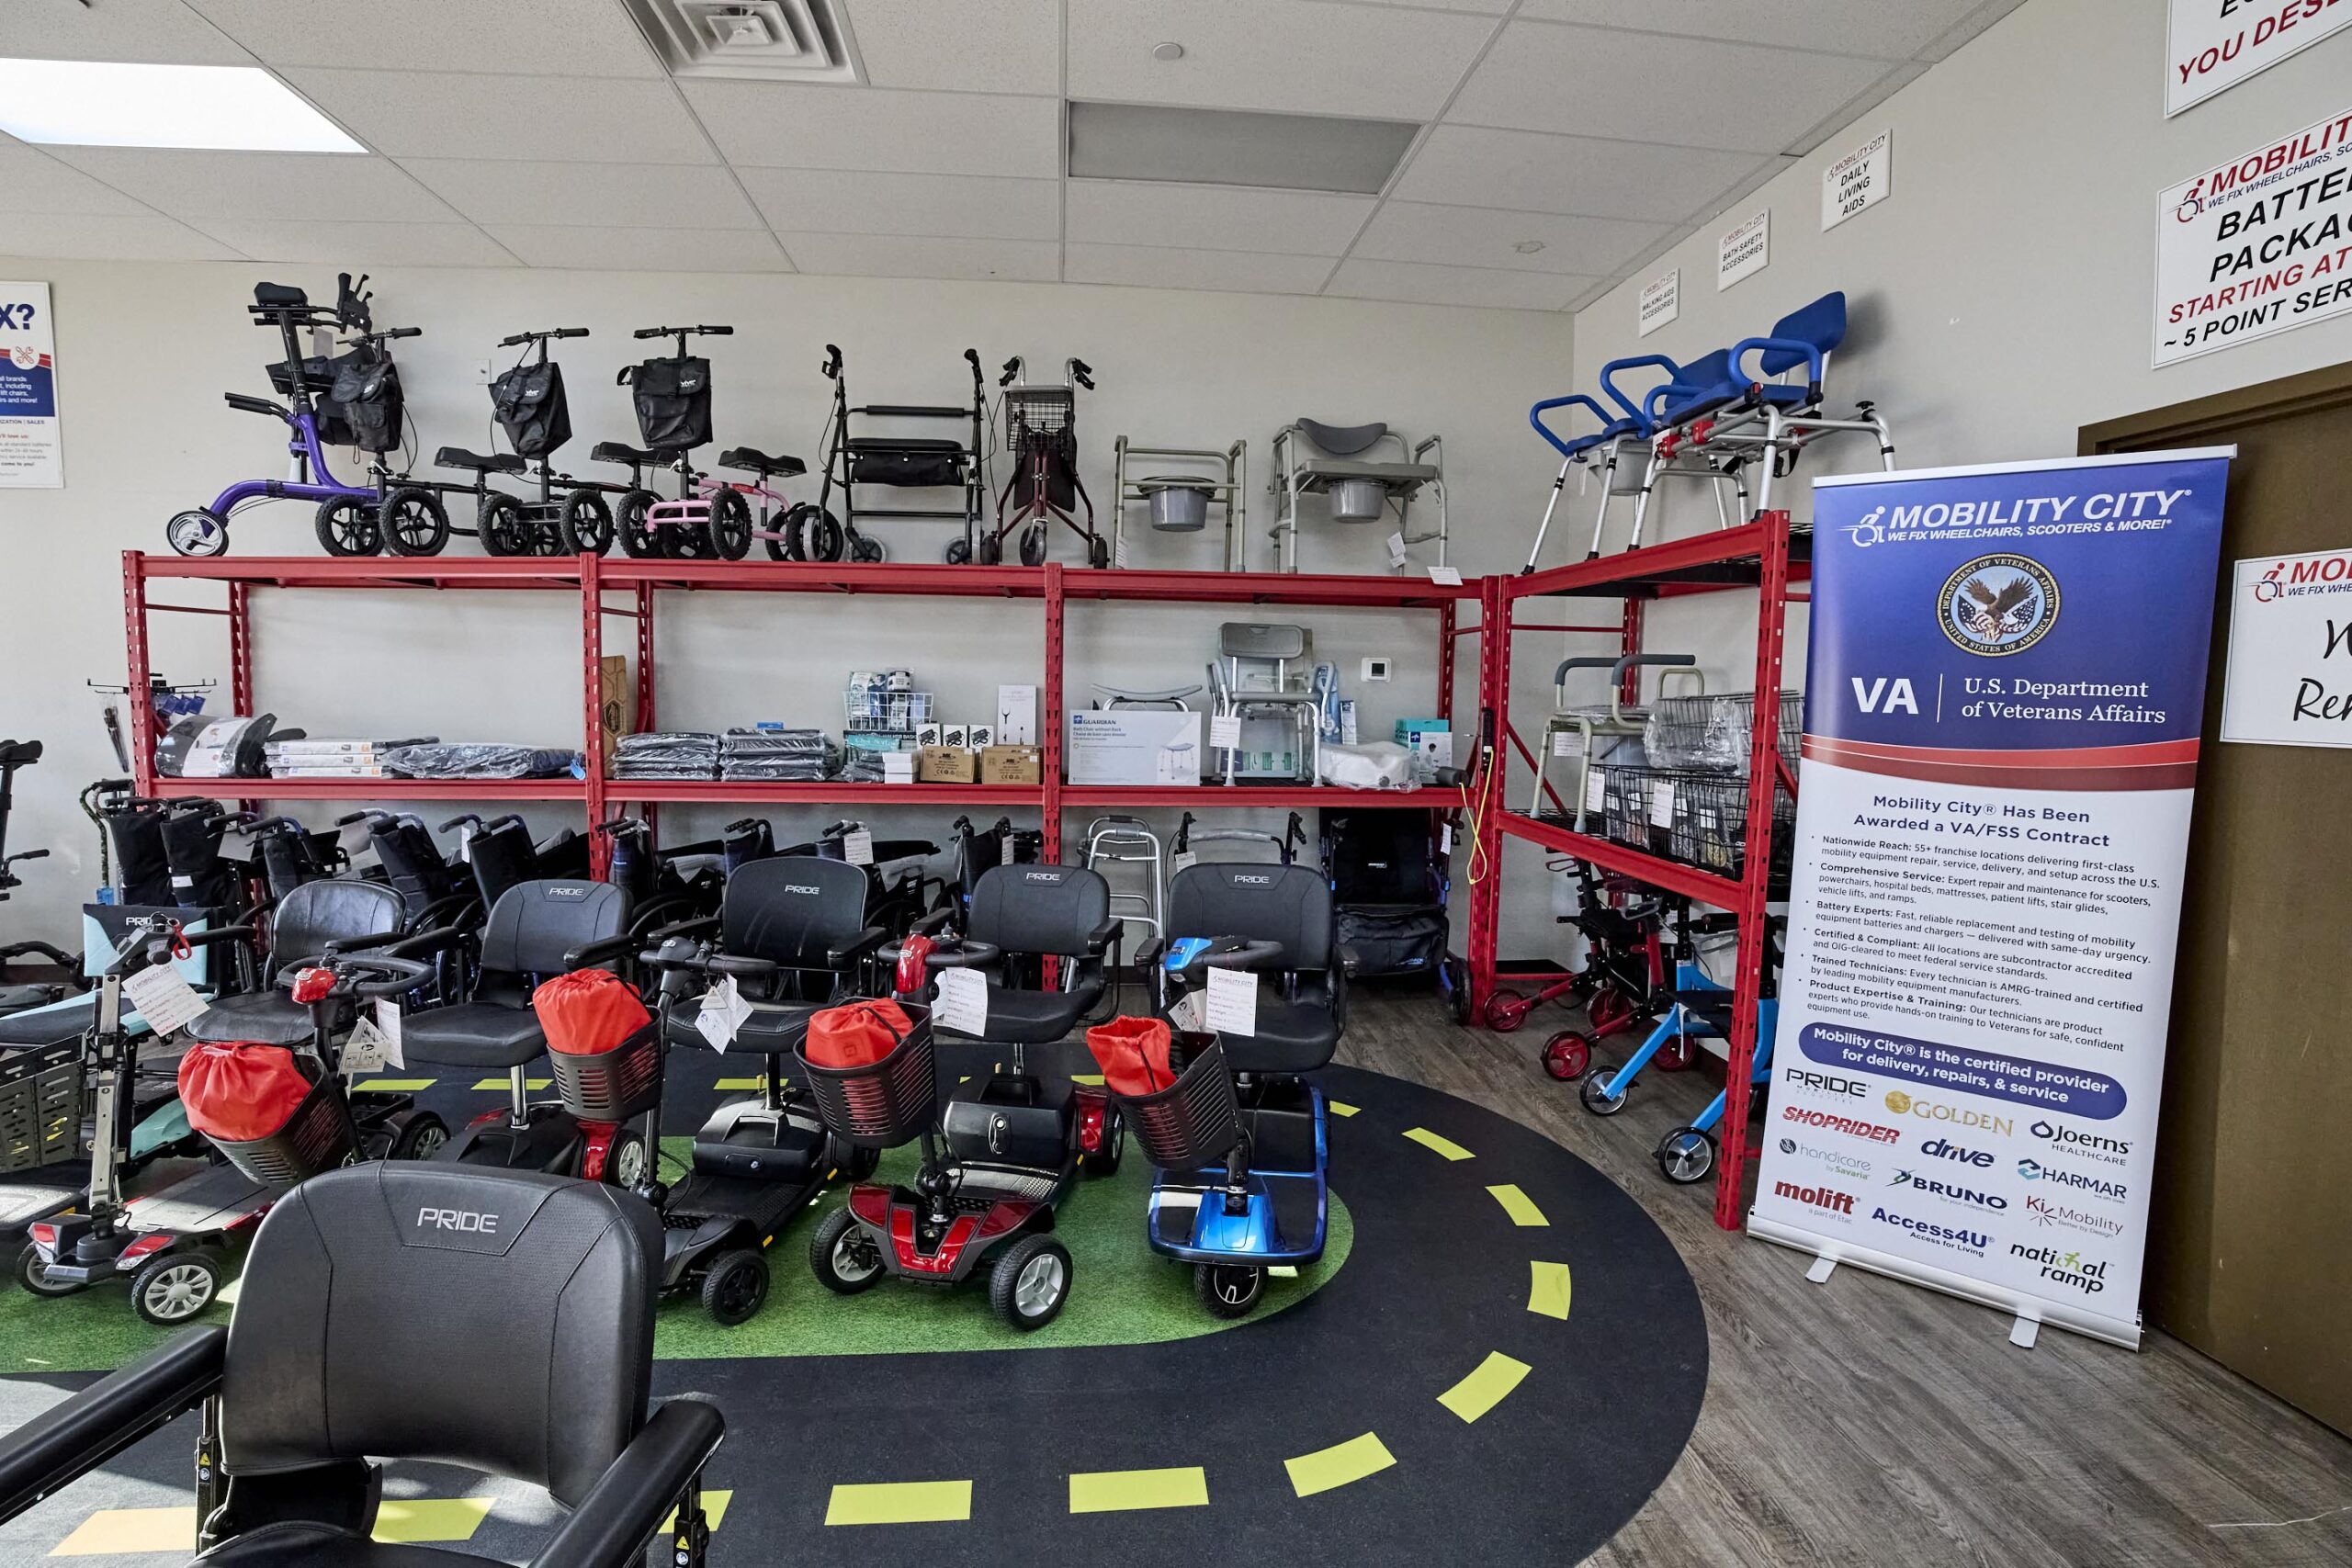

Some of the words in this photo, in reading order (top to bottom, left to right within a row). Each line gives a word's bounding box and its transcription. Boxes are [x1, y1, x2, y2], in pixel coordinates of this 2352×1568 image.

[2179, 31, 2244, 84] YOU
[1836, 144, 1869, 173] MOBILITY
[1870, 133, 1886, 151] CITY
[1841, 160, 1869, 186] DAILY
[2209, 196, 2225, 209] WE
[2227, 188, 2244, 201] FIX
[2246, 152, 2332, 193] WHEELCHAIRS,
[1838, 176, 1870, 203] LIVING
[2217, 167, 2352, 241] BATTE
[1842, 195, 1865, 216] AIDS
[1722, 242, 1763, 273] ACCESSORIES
[1723, 246, 1738, 262] BATH
[1739, 230, 1763, 252] SAFETY
[2210, 213, 2352, 282] PACKA
[2169, 264, 2303, 323] STARTING
[2311, 246, 2352, 278] AT
[1642, 294, 1663, 311] WALKING
[1642, 297, 1674, 321] ACCESSORIES
[2184, 327, 2196, 346] 5
[2203, 299, 2286, 342] POINT
[2293, 278, 2352, 313] SER
[1889, 494, 2076, 529] MOBILITY
[1887, 531, 1907, 541] WE
[1907, 530, 1929, 540] FIX
[1929, 525, 2023, 539] WHEELCHAIRS,
[2026, 522, 2102, 536] SCOOTERS
[2104, 521, 2115, 532] &
[1943, 565, 1976, 610] DEPARTMENT
[1979, 560, 1991, 569] OF
[1995, 558, 2041, 576] VETERANS
[2038, 575, 2053, 609] AFFAIRS
[2288, 587, 2305, 595] WE
[2308, 586, 2325, 594] FIX
[1945, 619, 1967, 644] UNITED
[1969, 641, 2000, 652] STATES
[2005, 642, 2016, 650] OF
[2019, 618, 2050, 647] AMERICA
[1851, 677, 1918, 715] VA
[1964, 677, 2006, 694] U.S.
[2013, 678, 2149, 700] Department
[1962, 700, 1984, 717] of
[1987, 702, 2082, 720] Veterans
[2086, 704, 2165, 724] Affairs
[1873, 795, 1941, 813] Mobility
[2003, 805, 2036, 818] Has
[2042, 807, 2089, 823] Been
[1853, 814, 1928, 830] Awarded
[1934, 823, 1944, 832] a
[1951, 821, 2019, 839] VA/FSS
[2026, 828, 2109, 847] Contract
[1822, 835, 1876, 848] Nationwide
[1879, 840, 1912, 852] Reach:
[1915, 843, 1931, 852] 55+
[1934, 845, 1977, 857] franchise
[1980, 850, 2025, 862] locations
[2027, 854, 2079, 869] delivering
[2082, 859, 2134, 874] first-class
[549, 887, 583, 897] PRIDE
[785, 885, 820, 895] PRIDE
[1026, 872, 1060, 882] PRIDE
[1234, 874, 1269, 884] PRIDE
[126, 917, 153, 926] PRID
[1816, 900, 1851, 913] Battery
[1853, 905, 1893, 918] Experts:
[1895, 909, 1917, 920] Fast,
[1918, 913, 1953, 925] reliable
[1955, 919, 2016, 932] replacement
[2018, 926, 2037, 935] and
[2040, 928, 2075, 942] testing
[2077, 933, 2088, 942] of
[2090, 936, 2136, 950] mobility
[1812, 953, 1847, 966] Trained
[1849, 959, 1906, 976] Technicians:
[1909, 968, 1936, 981] Every
[1938, 973, 1987, 987] technician
[1989, 980, 1997, 989] is
[1999, 982, 2072, 1001] AMRG-trained
[2074, 995, 2095, 1005] and
[2097, 999, 2143, 1012] certified
[1814, 1027, 1871, 1049] Mobility
[1919, 1046, 1931, 1059] is
[1935, 1050, 1961, 1065] the
[1964, 1056, 2031, 1078] certified
[2035, 1069, 2109, 1093] provider
[1842, 1048, 1863, 1063] for
[1867, 1055, 1928, 1077] delivery,
[1933, 1068, 1990, 1089] repairs,
[1994, 1078, 2006, 1090] &
[2009, 1082, 2068, 1102] service
[1782, 1106, 1900, 1144] SHOPRIDER
[1912, 1100, 2013, 1137] GOLDEN
[1920, 1139, 1995, 1168] drive
[2052, 1144, 2127, 1166] HEALTHCARE
[2053, 1126, 2130, 1156] Joerns
[1801, 1143, 1871, 1171] handicare
[1836, 1166, 1868, 1180] Savaria
[2042, 1167, 2127, 1199] HARMAR
[1775, 1181, 1854, 1214] molift
[1913, 1177, 2007, 1210] BRUNO
[417, 1207, 499, 1234] PRIDE
[1814, 1209, 1827, 1218] part
[2027, 1196, 2045, 1213] Ki
[2059, 1206, 2123, 1235] Mobility
[1910, 1232, 1940, 1245] Access
[1943, 1240, 1955, 1249] for
[1958, 1244, 1984, 1258] Living
[2040, 1266, 2103, 1294] ramp
